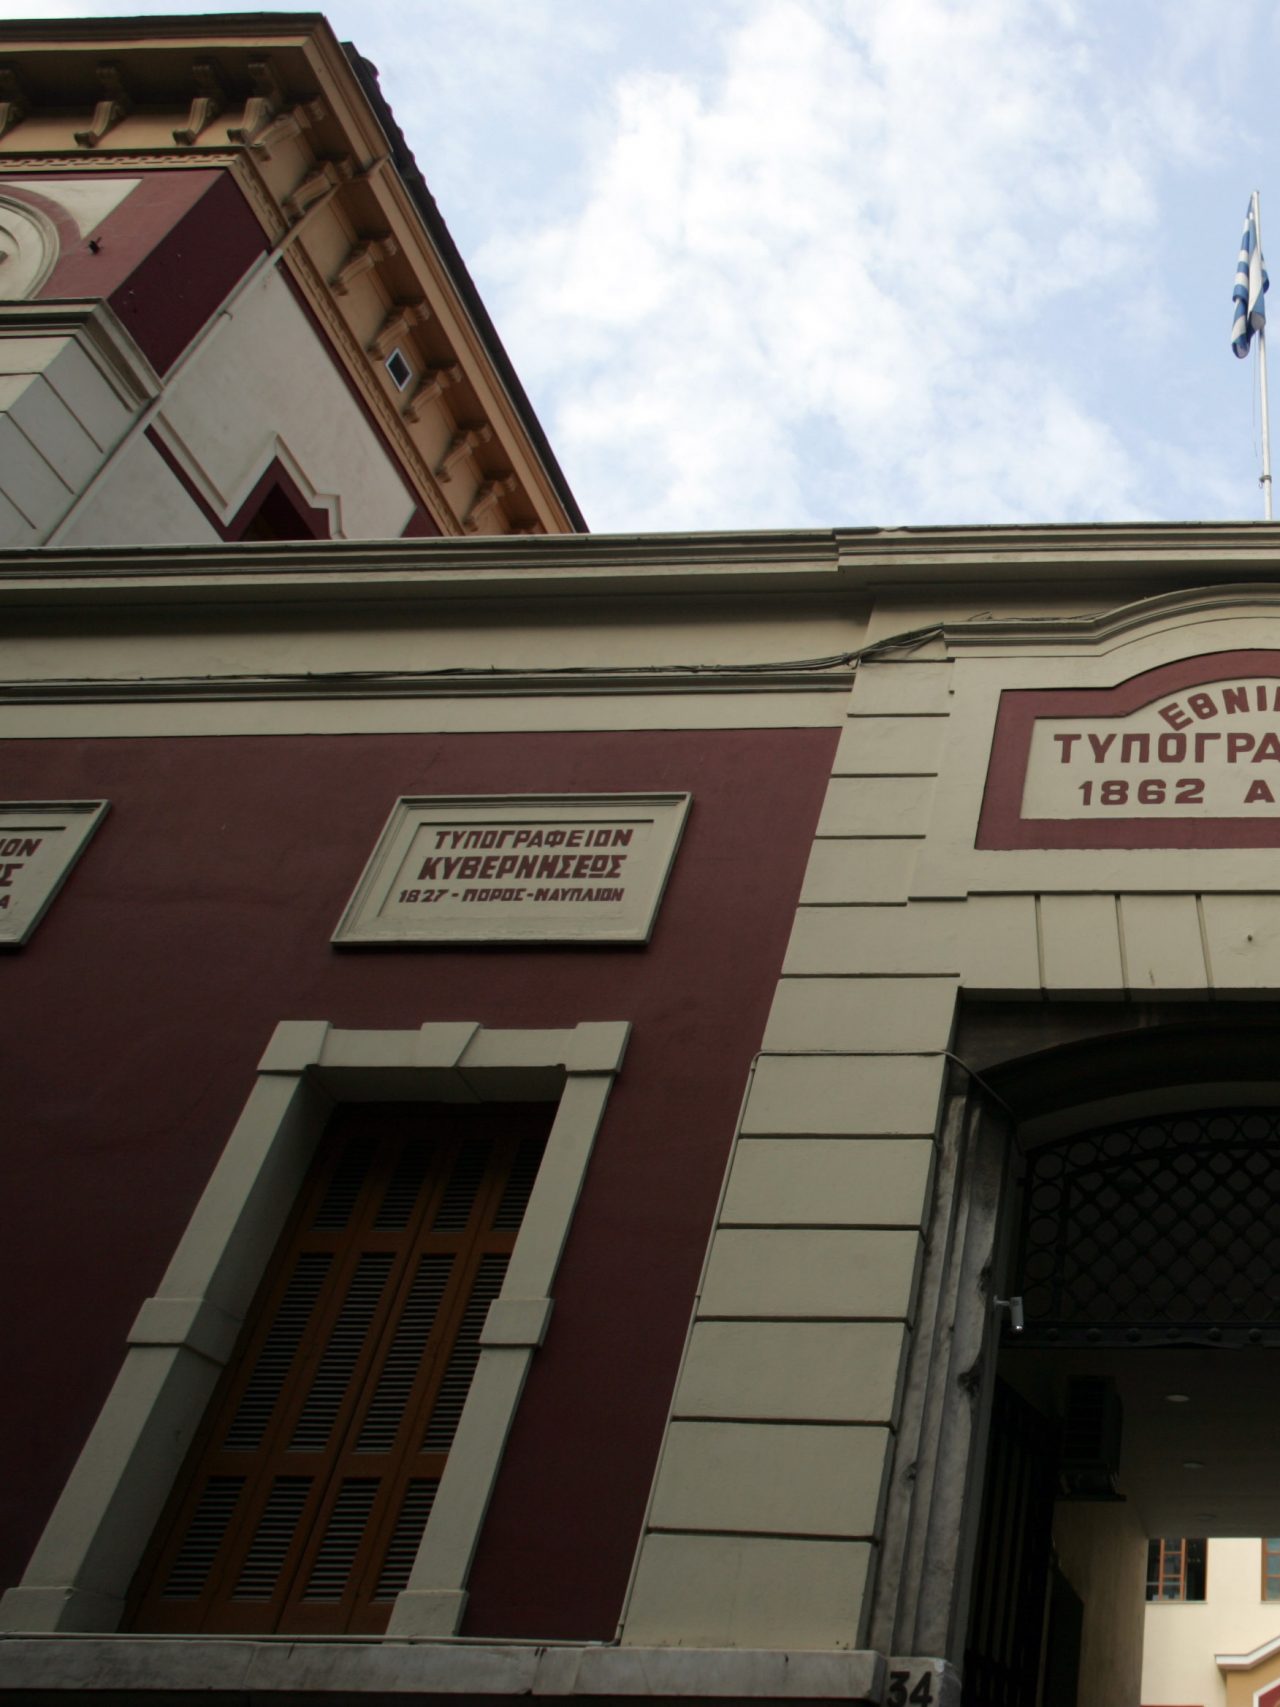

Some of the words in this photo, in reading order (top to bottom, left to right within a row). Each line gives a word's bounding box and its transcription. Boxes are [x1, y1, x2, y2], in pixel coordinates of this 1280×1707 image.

[1078, 779, 1205, 806] 1862
[435, 829, 633, 849] ΤΥΠΟΓΡΑΦΕΙΟΝ
[417, 855, 627, 880] ΚΥΒΕΡΝΗΣΕΩΣ
[887, 1670, 934, 1707] 34
